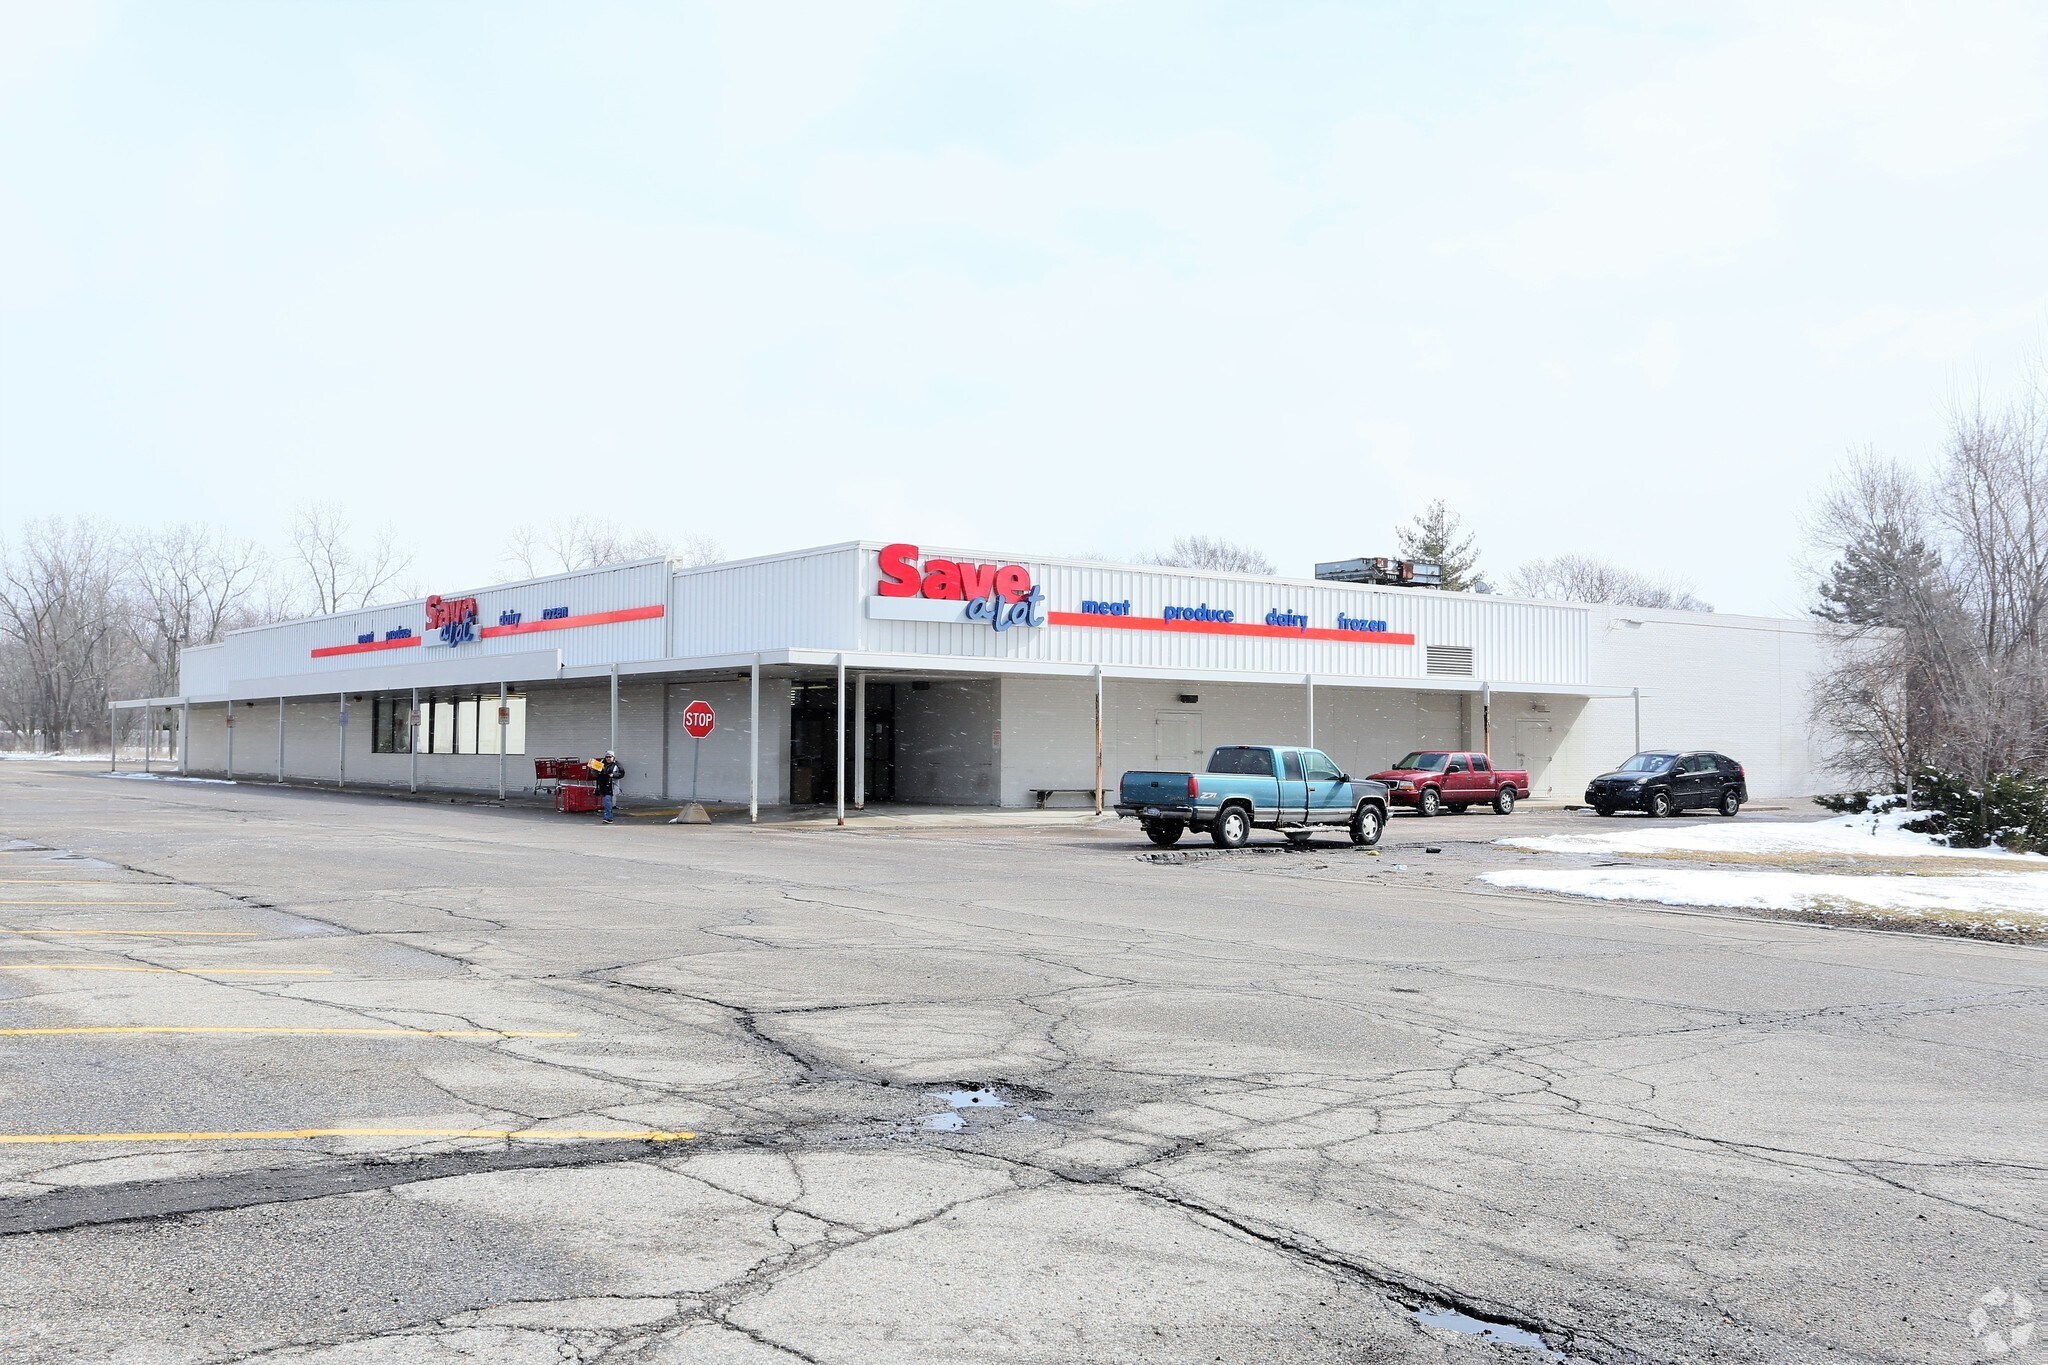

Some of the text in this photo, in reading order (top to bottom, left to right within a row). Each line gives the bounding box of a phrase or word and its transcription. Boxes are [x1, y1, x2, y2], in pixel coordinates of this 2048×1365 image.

[878, 543, 1030, 604] Save
[426, 595, 477, 631] Save
[1081, 599, 1387, 632] meat produce dairy frozen
[685, 711, 713, 727] STOP
